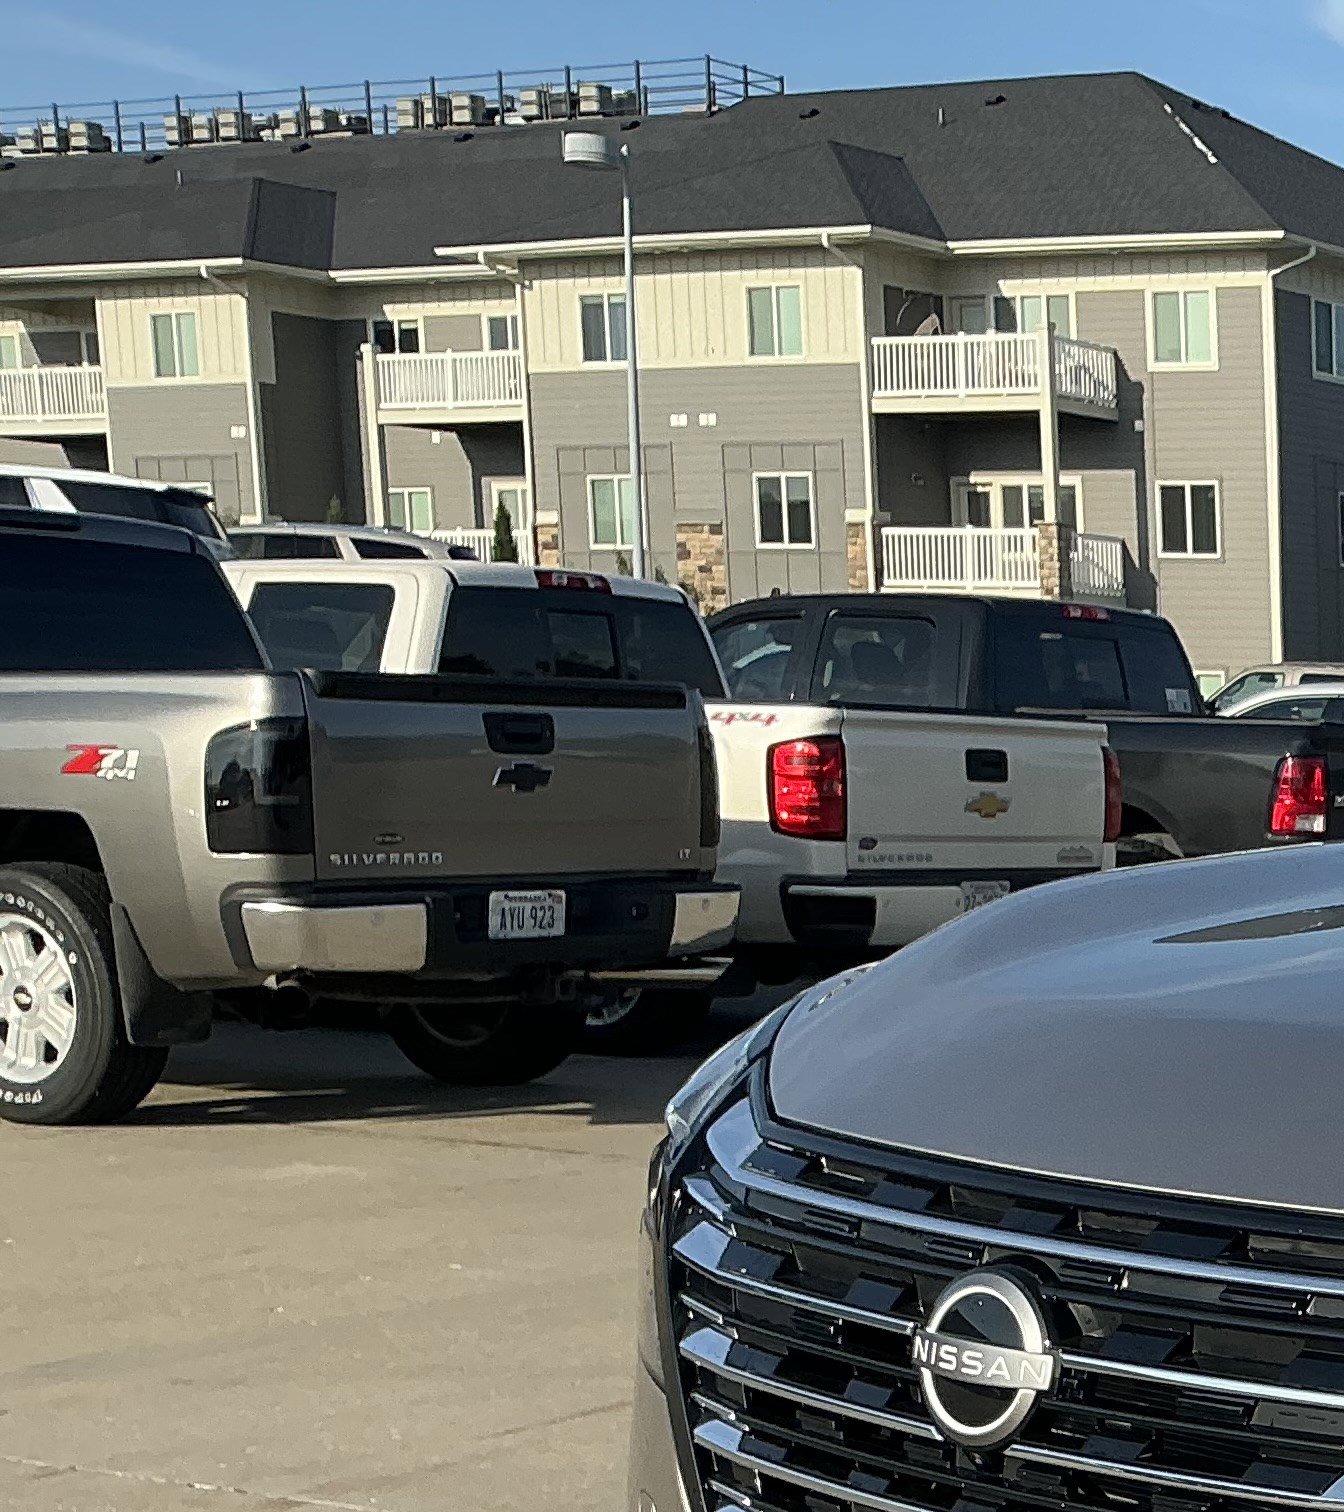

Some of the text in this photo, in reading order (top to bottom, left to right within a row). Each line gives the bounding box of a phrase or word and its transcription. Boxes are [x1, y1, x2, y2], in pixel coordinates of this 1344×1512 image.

[61, 744, 140, 774] Z71
[500, 905, 555, 931] AYU 923
[912, 1334, 1047, 1384] NISSAN
